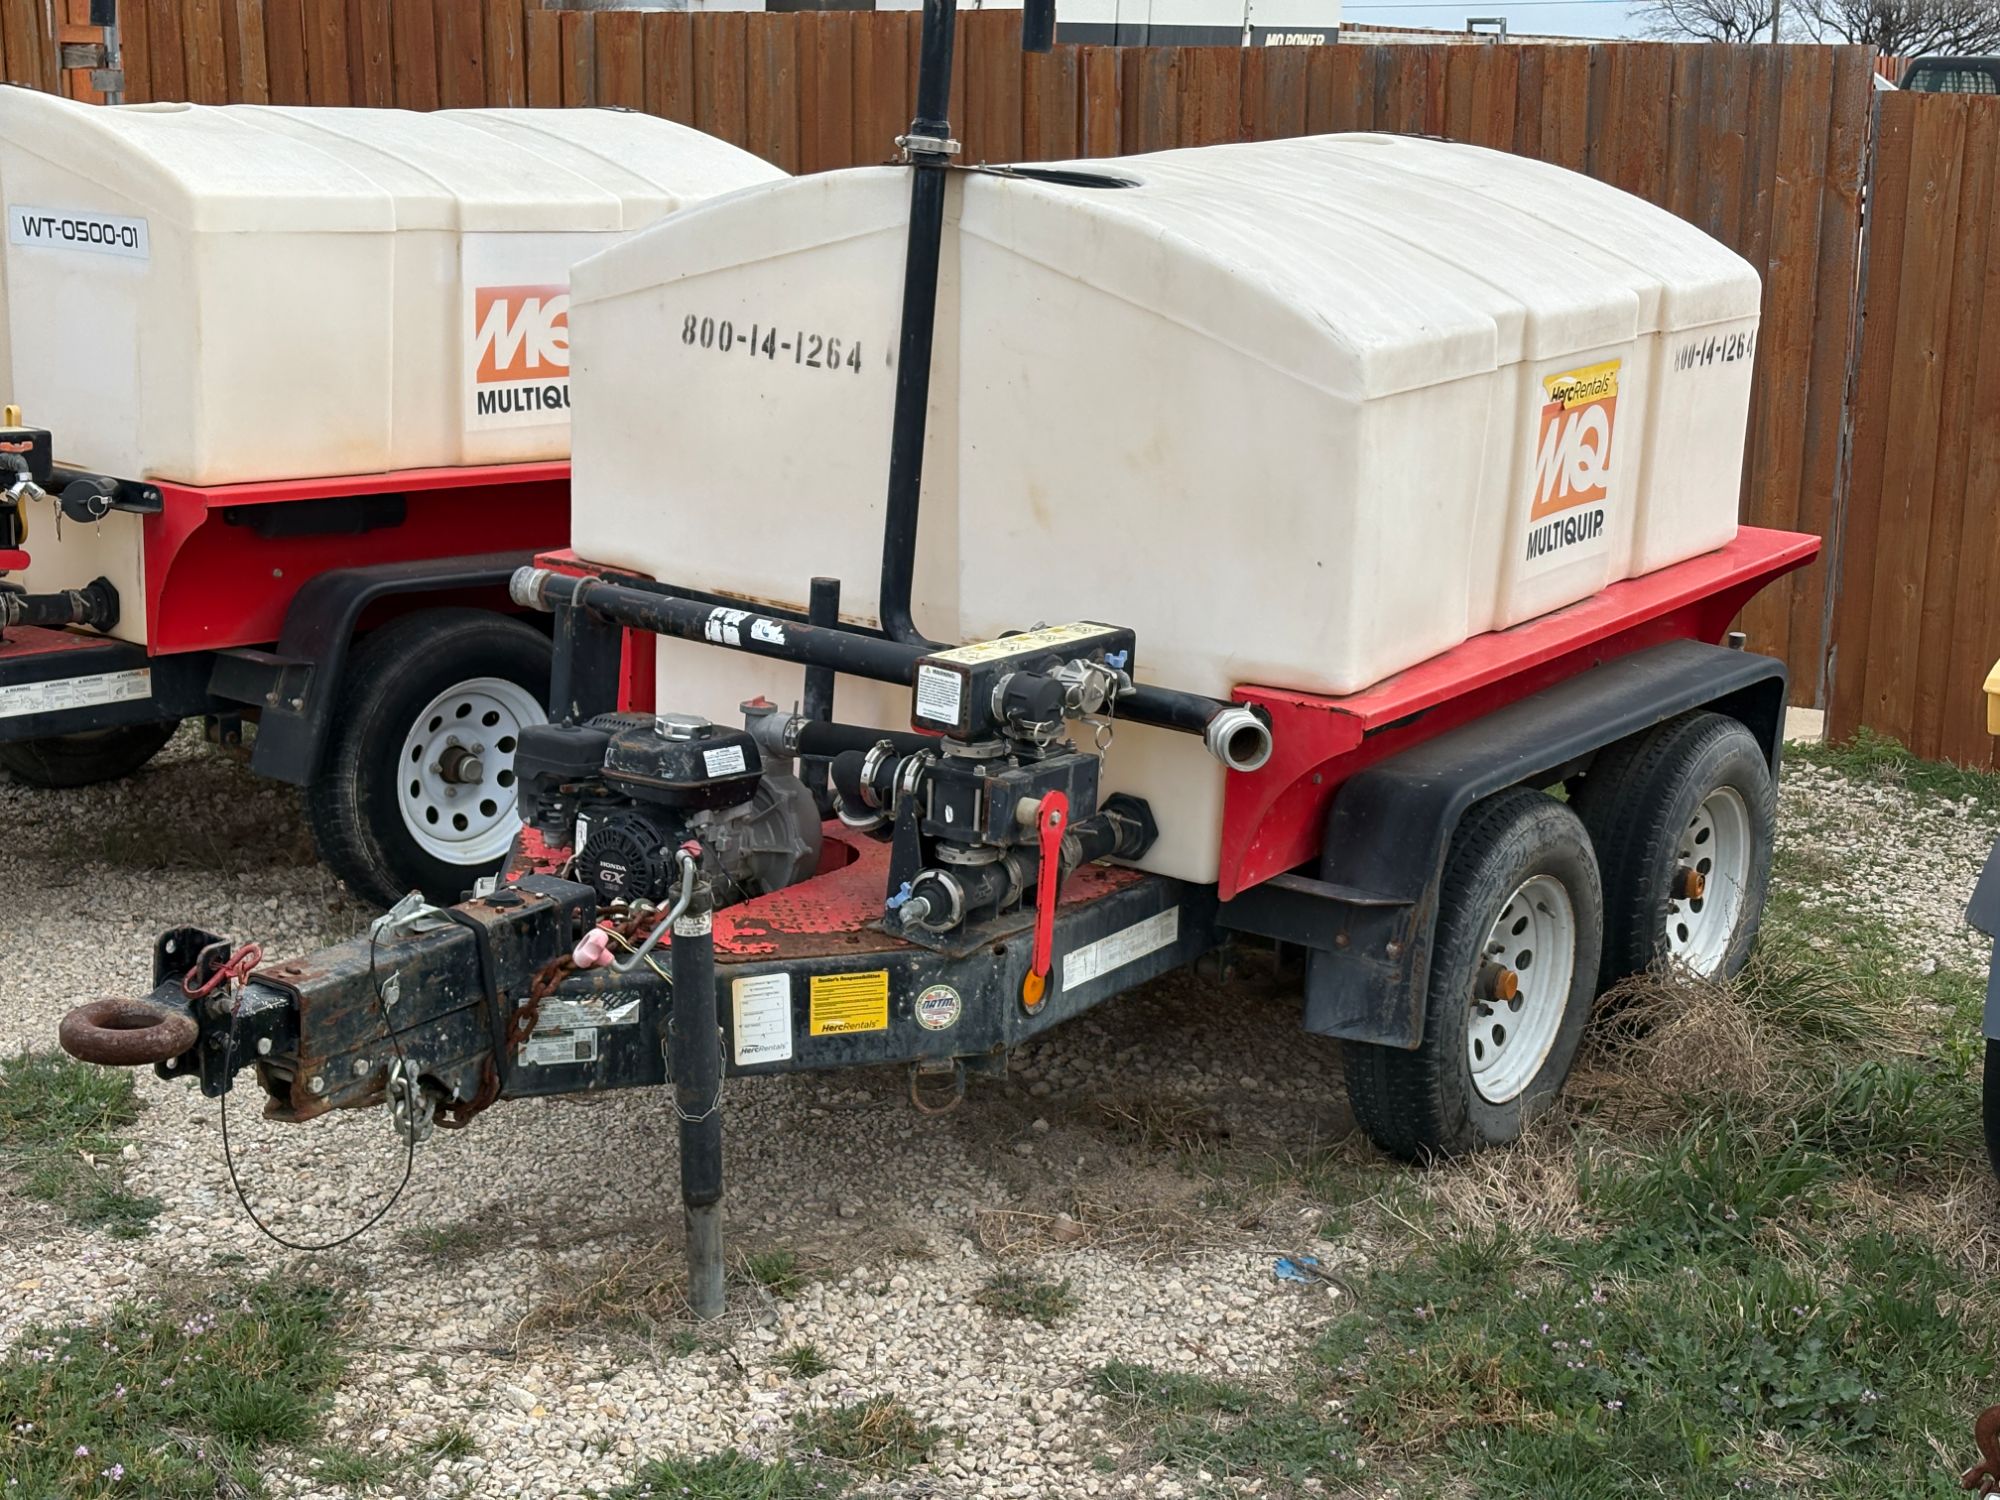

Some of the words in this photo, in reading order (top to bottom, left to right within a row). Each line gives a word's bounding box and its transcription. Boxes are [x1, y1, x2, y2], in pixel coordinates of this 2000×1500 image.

[22, 215, 138, 249] WT-0500-01
[681, 314, 862, 374] 800-14-1264
[1534, 404, 1611, 504] MQ
[1526, 509, 1604, 561] MULTIQUIP
[600, 860, 627, 872] HONDA
[600, 870, 625, 885] GX
[822, 1020, 877, 1032] HercRentals
